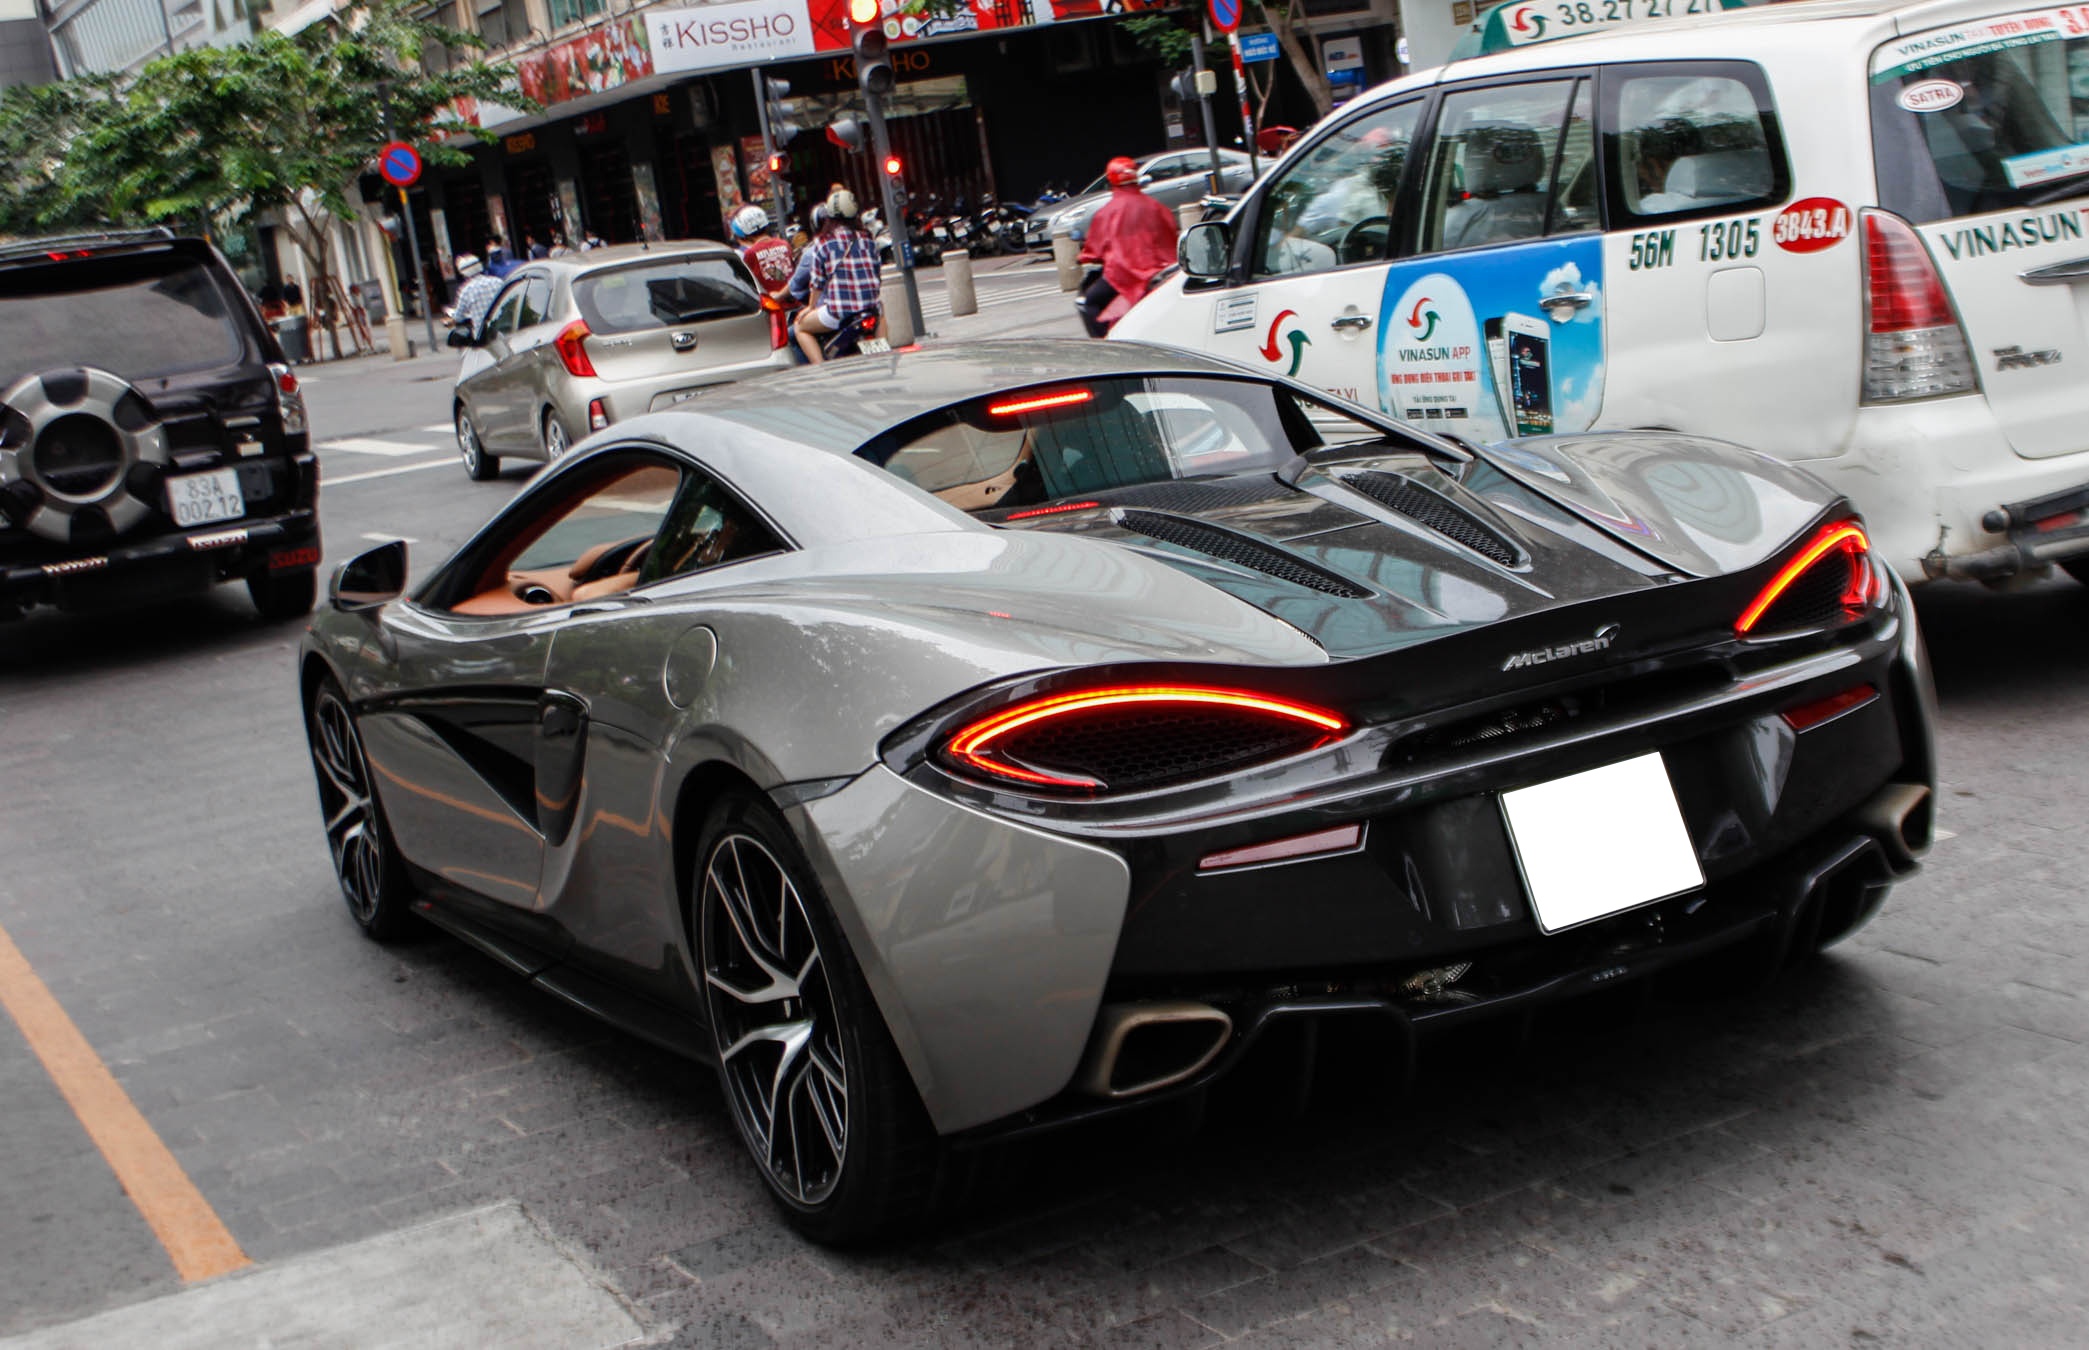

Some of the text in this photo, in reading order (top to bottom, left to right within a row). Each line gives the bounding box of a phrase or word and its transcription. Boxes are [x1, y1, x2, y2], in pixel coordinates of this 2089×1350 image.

[1557, 0, 1632, 26] 38.27
[675, 13, 795, 49] KISSHO
[731, 36, 798, 51] Restaurant
[1897, 32, 1966, 55] VINASUN
[1909, 88, 1954, 106] SATRA
[1775, 207, 1848, 244] 3843.A
[1940, 211, 2082, 260] VINASUN
[1629, 217, 1761, 271] 56M 1305
[1399, 346, 1471, 361] VINASUN APP
[187, 476, 224, 499] 83A
[1501, 636, 1611, 672] McLaren
